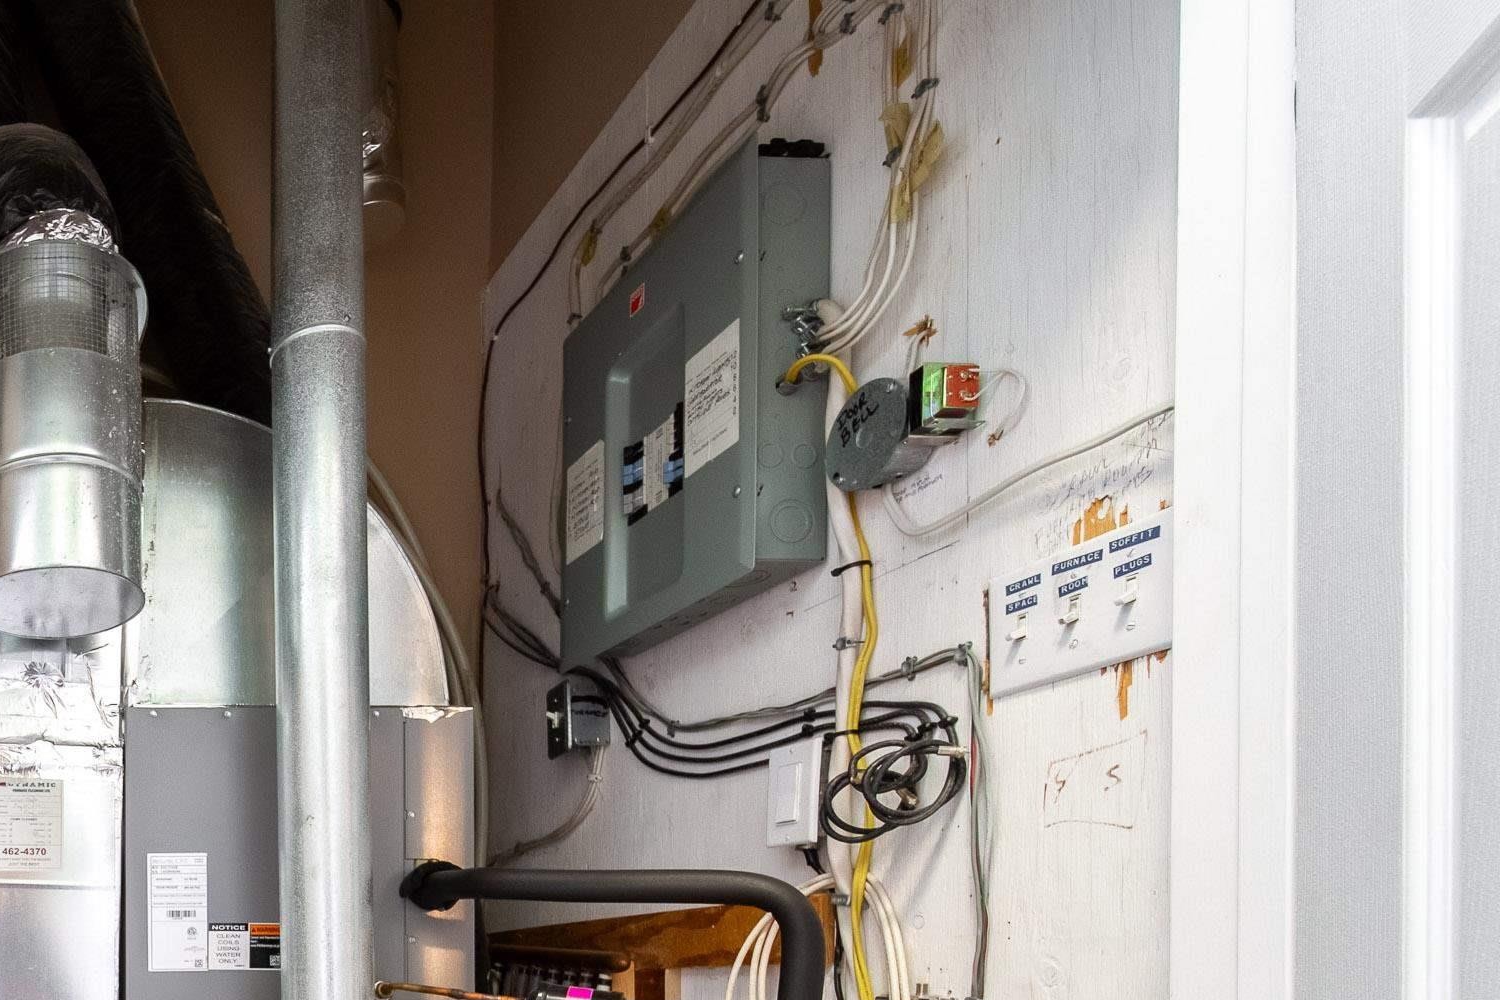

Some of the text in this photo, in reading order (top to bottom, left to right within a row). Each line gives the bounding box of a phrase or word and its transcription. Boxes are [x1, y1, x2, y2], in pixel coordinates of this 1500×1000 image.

[842, 402, 880, 448] BELL
[1112, 528, 1154, 550] SOFFIT
[1053, 550, 1100, 572] FURNACE
[1116, 554, 1150, 576] PLUGS
[1009, 576, 1039, 592] CRAWL
[1061, 578, 1088, 594] ROOM
